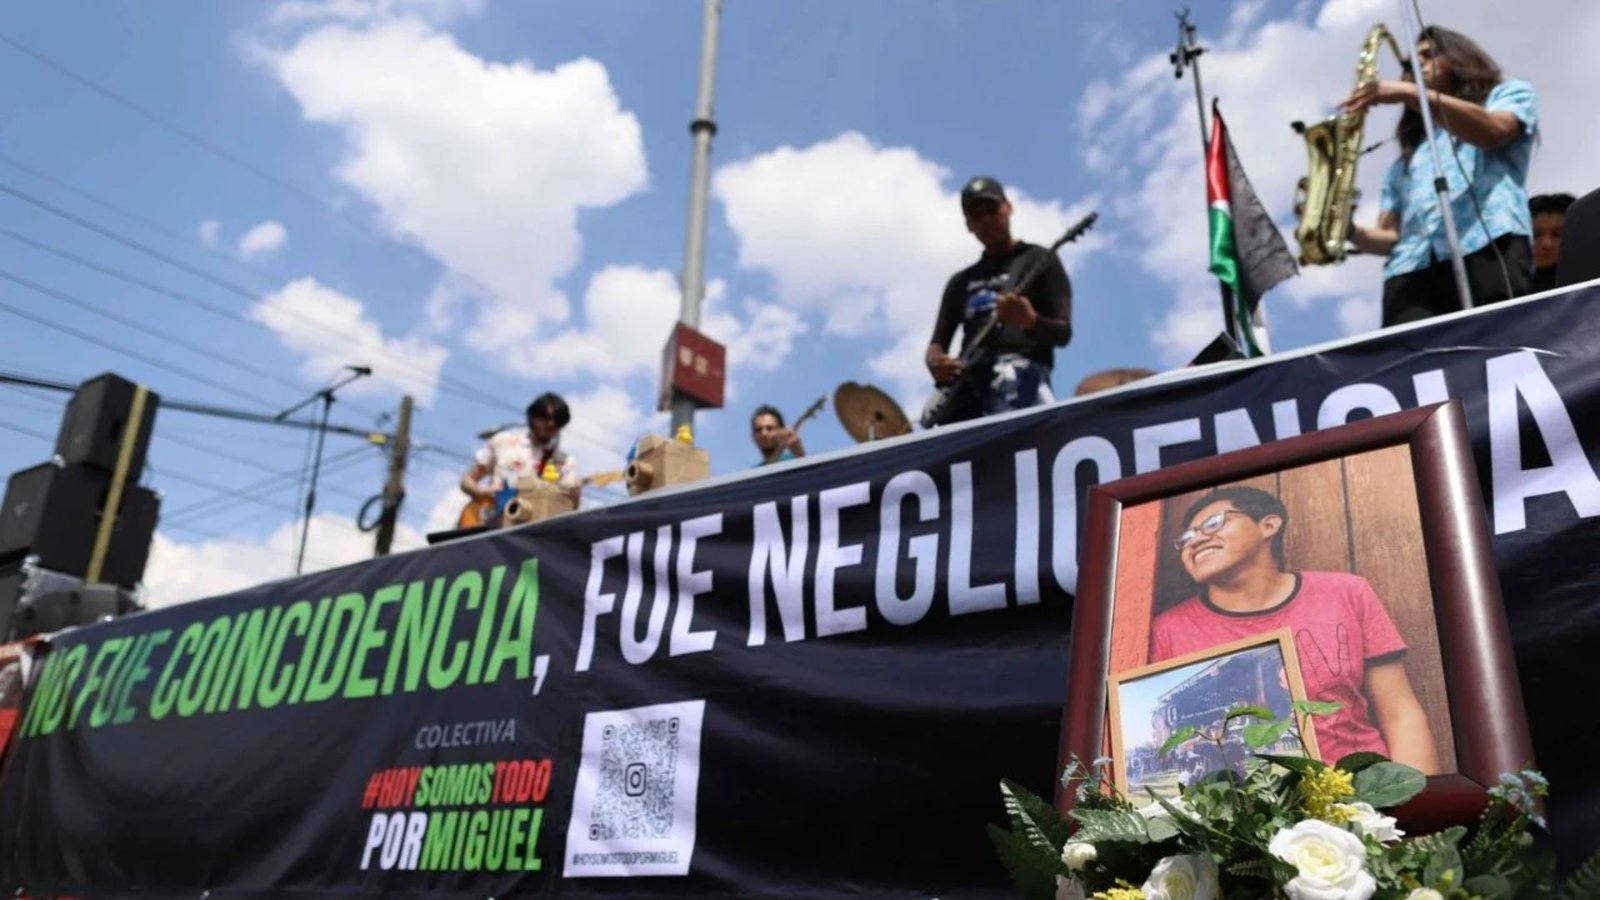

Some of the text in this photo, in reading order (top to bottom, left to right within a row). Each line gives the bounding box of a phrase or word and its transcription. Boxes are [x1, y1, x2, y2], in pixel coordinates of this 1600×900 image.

[18, 348, 1600, 739] NO FUE COINCIDENCIA, FUE NEGLIGA
[415, 718, 516, 749] COLECTIVA
[361, 759, 552, 808] #HOYSOMOSTODO
[360, 808, 544, 871] PORMIGUEL
